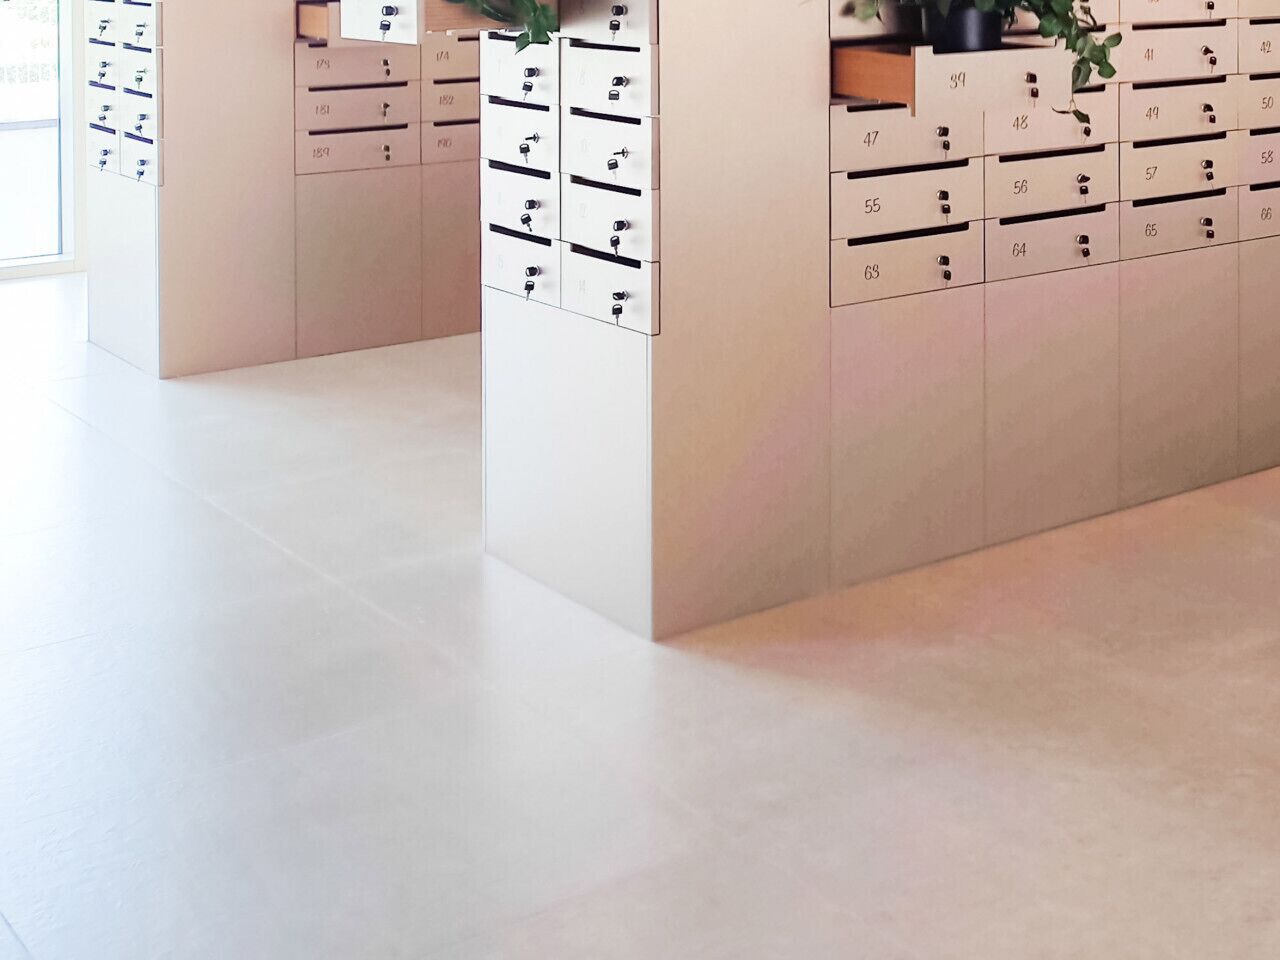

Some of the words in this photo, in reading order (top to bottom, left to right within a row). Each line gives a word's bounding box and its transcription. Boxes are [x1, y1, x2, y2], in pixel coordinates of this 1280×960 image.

[1144, 47, 1154, 62] 41
[1259, 40, 1272, 54] 42
[950, 71, 966, 89] 39
[1261, 95, 1274, 110] 50
[1145, 105, 1160, 121] 49
[1012, 114, 1029, 131] 48
[863, 130, 880, 148] 47
[1260, 149, 1274, 165] 58
[1145, 165, 1158, 181] 57
[1013, 178, 1028, 195] 56
[864, 197, 881, 214] 55
[1260, 206, 1273, 221] 66
[1144, 222, 1158, 238] 65
[1012, 242, 1027, 258] 64
[864, 263, 880, 281] 63
